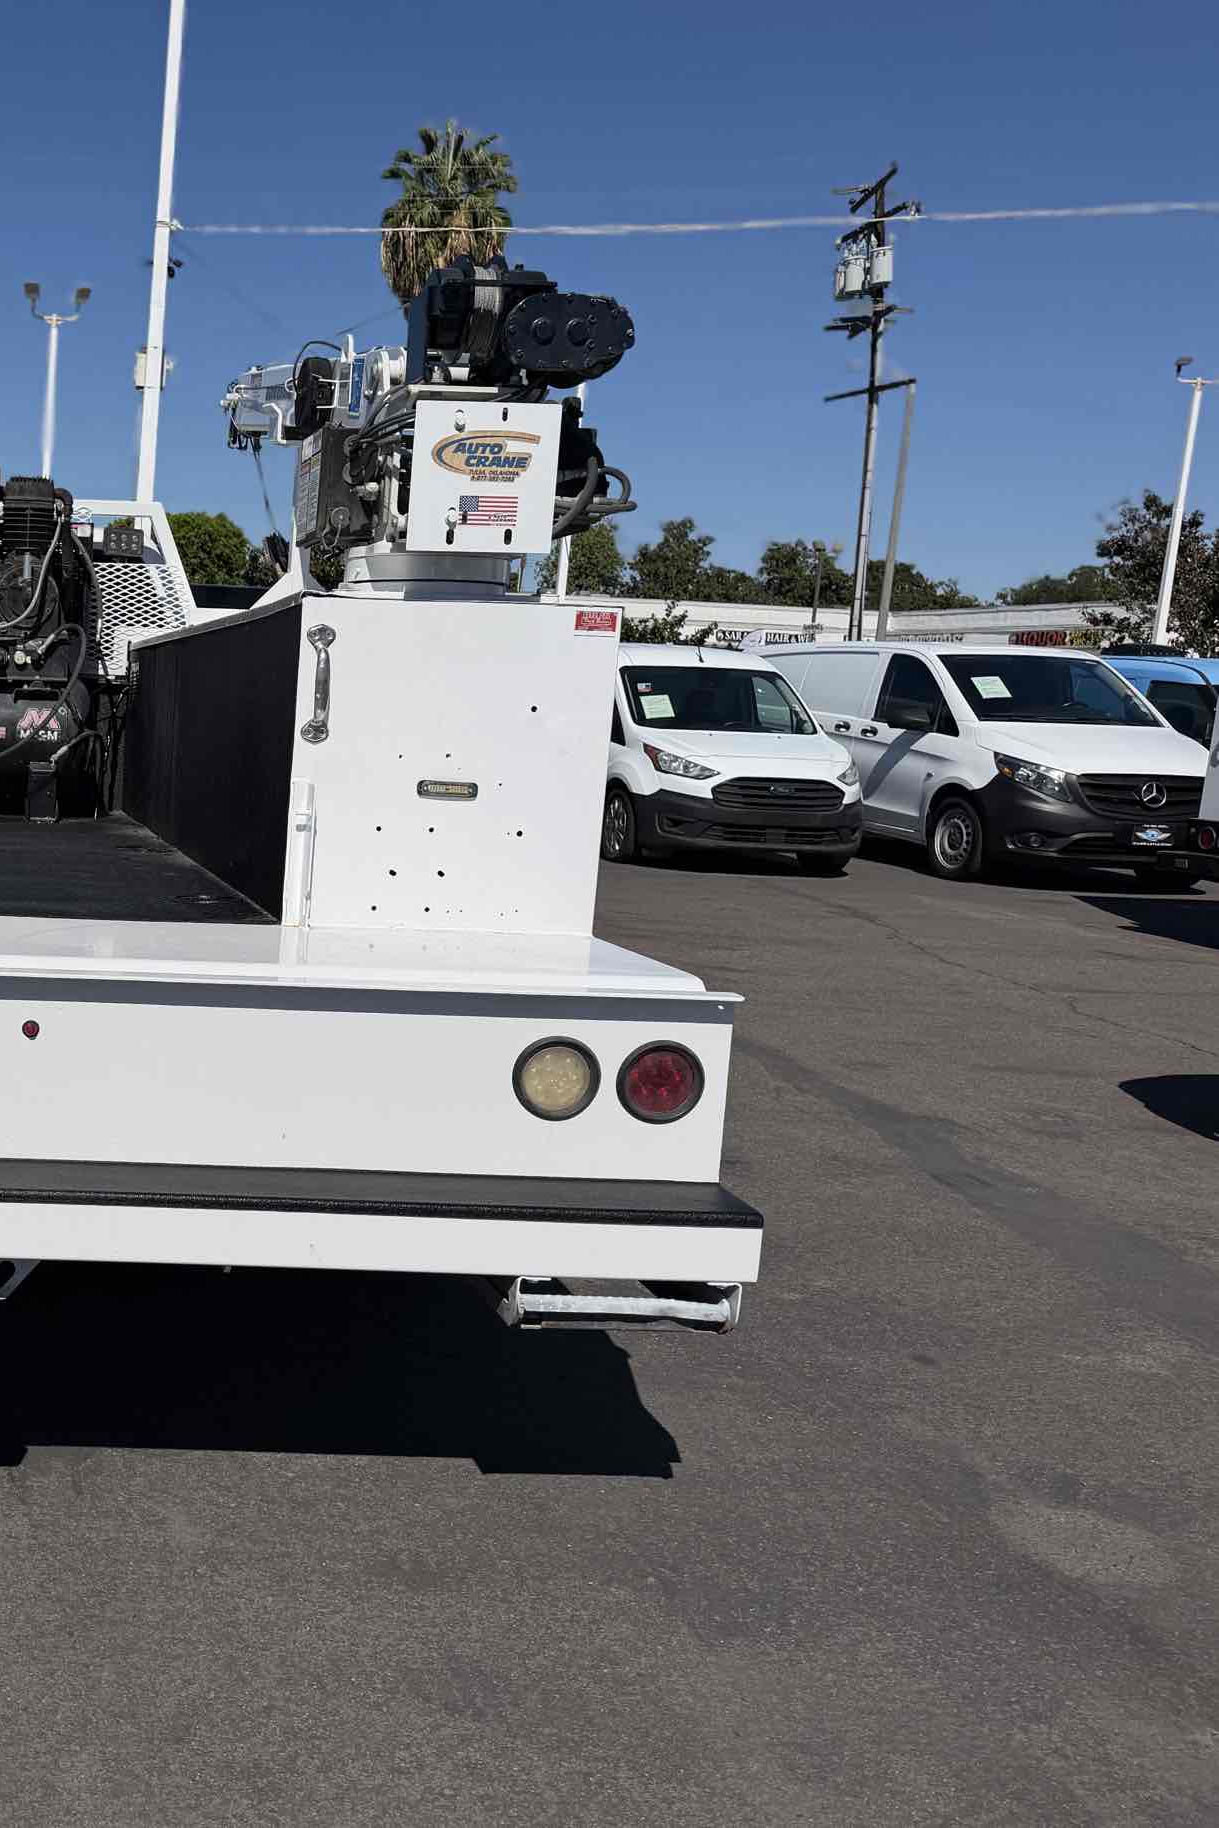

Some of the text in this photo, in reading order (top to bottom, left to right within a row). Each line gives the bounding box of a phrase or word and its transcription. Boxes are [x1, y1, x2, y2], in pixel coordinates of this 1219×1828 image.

[452, 442, 503, 455] AUTO
[464, 454, 529, 468] CRANE
[766, 632, 790, 643] HAIR
